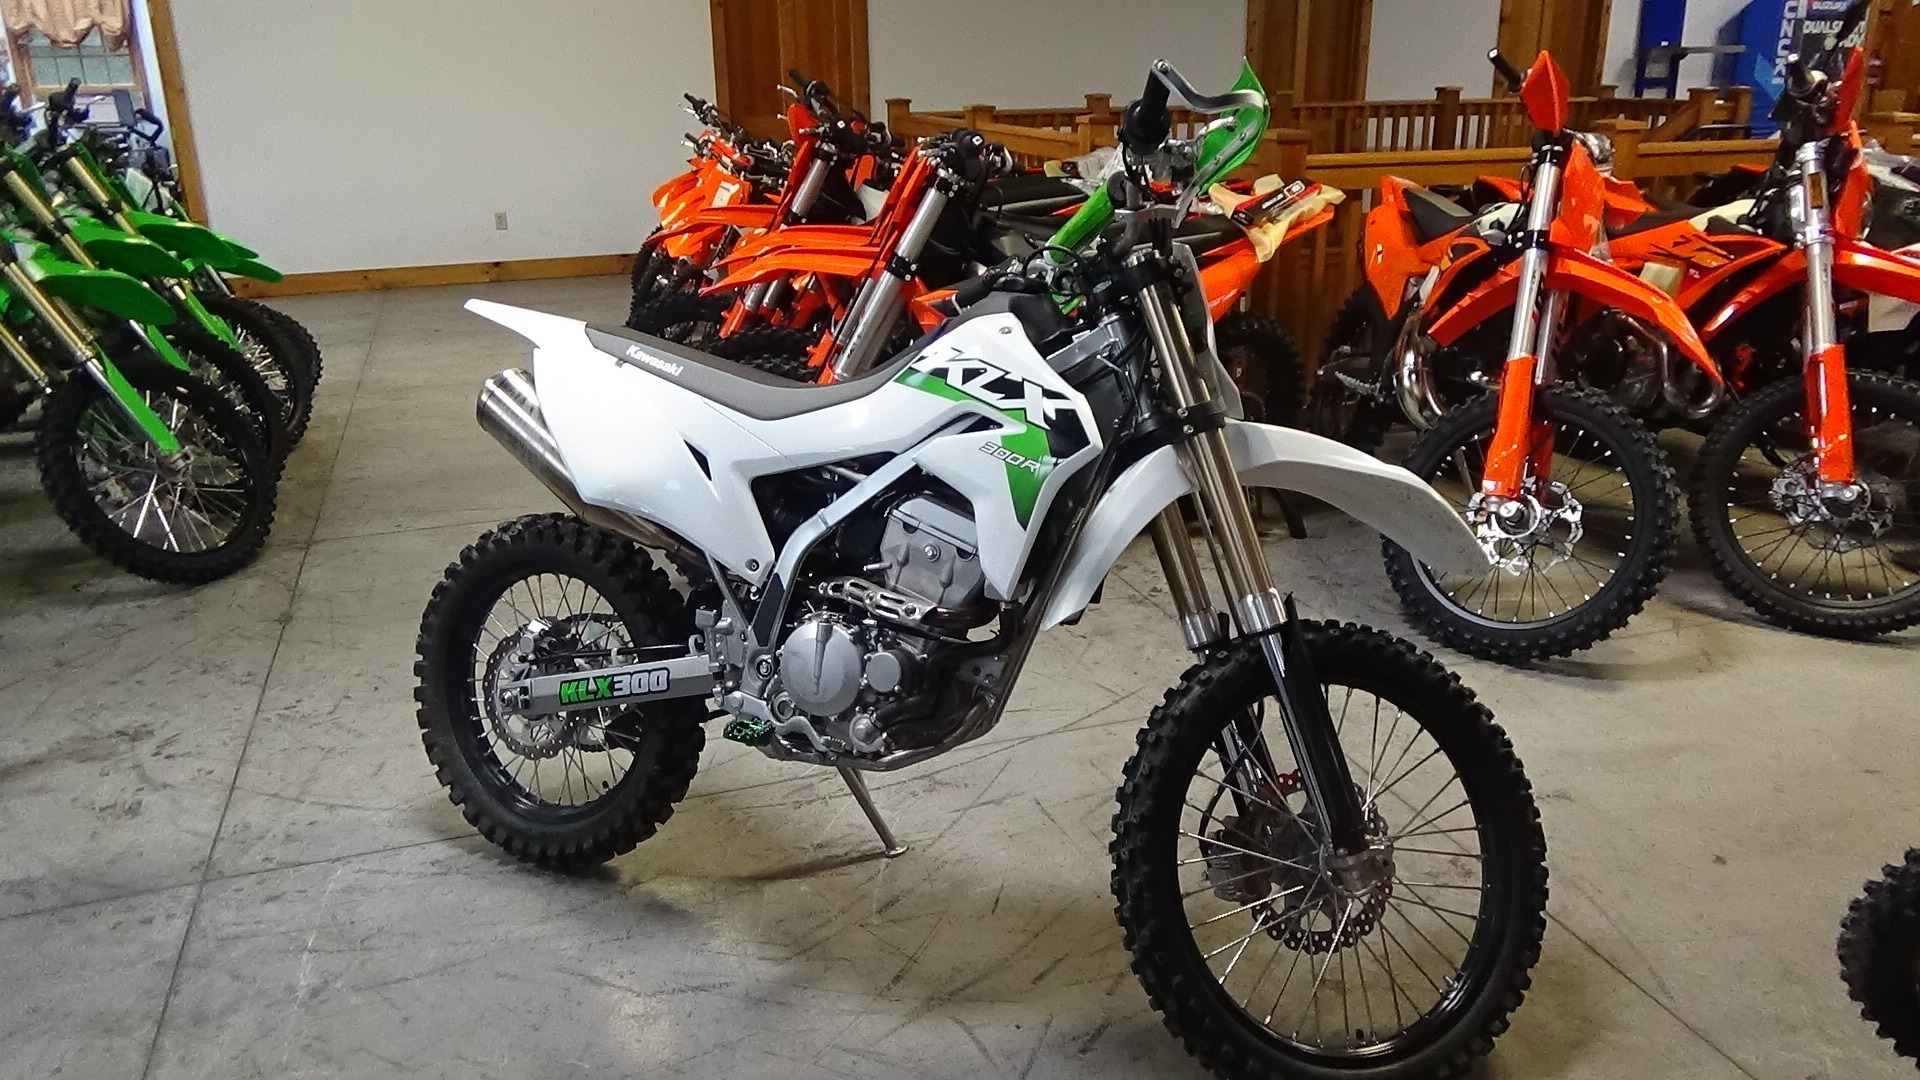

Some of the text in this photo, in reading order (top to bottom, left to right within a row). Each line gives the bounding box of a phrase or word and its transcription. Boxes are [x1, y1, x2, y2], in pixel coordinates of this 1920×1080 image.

[626, 345, 684, 376] Kawasaki
[911, 347, 1078, 431] KLX
[979, 441, 1041, 473] 300R
[560, 669, 669, 704] KLX300
